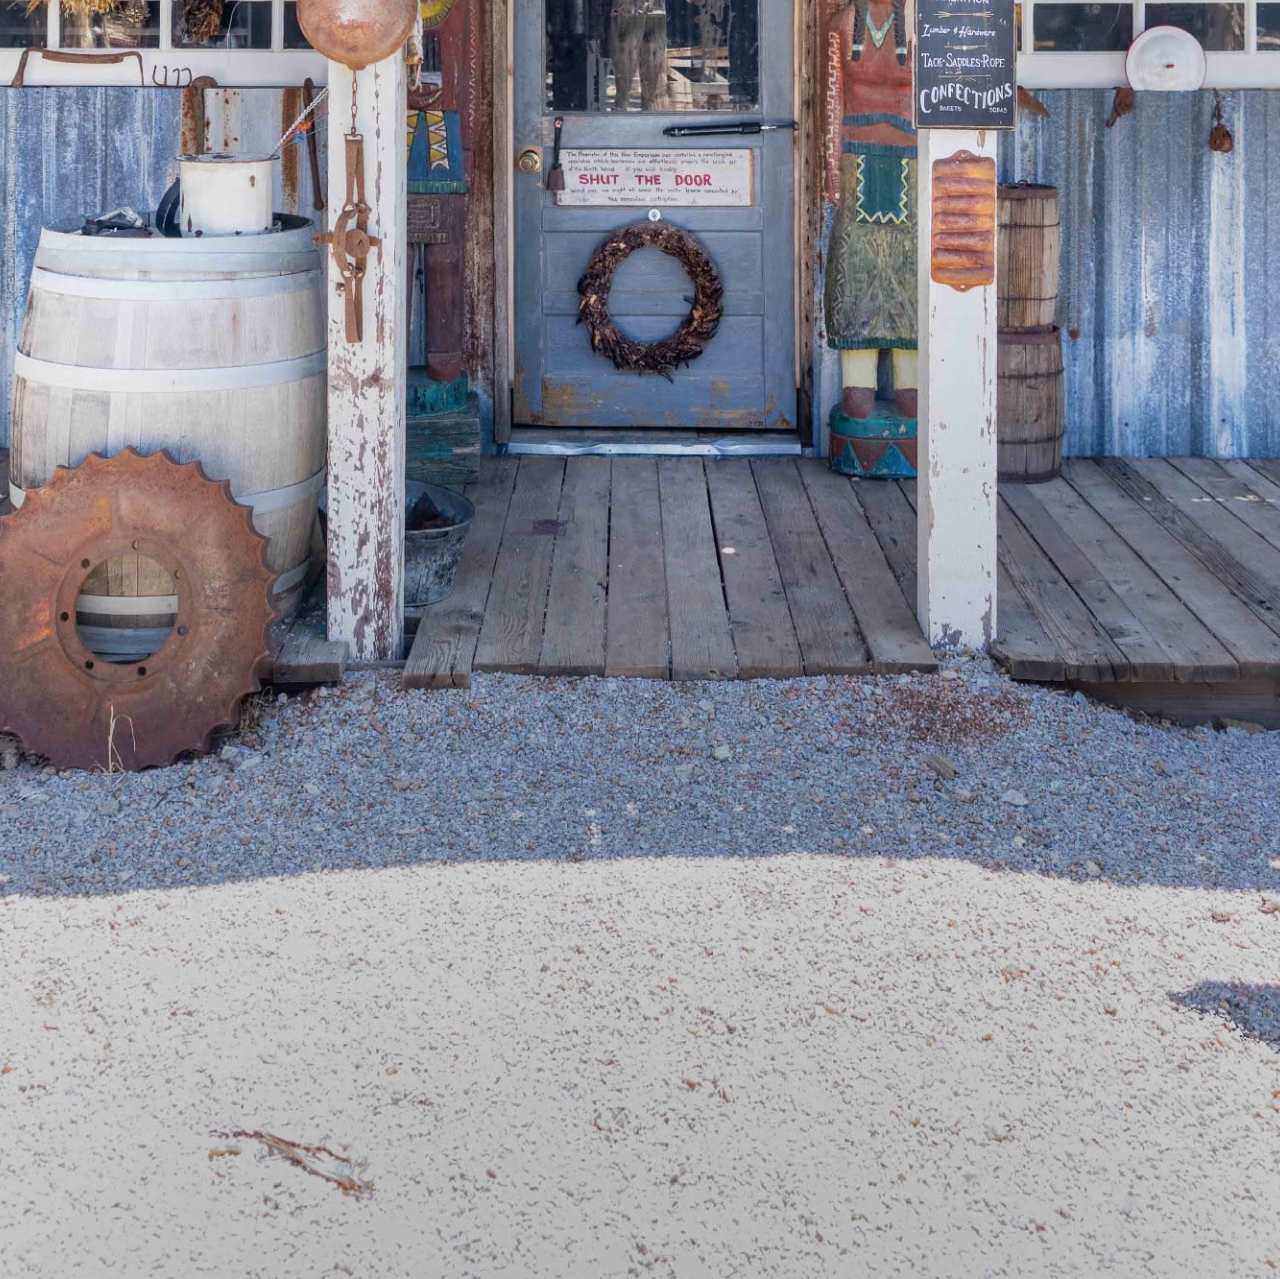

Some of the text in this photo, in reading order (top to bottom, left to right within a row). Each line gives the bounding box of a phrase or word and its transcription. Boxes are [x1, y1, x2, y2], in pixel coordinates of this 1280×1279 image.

[919, 82, 1013, 114] CONFECTIONS
[578, 173, 713, 186] SHUT THE DOOR
